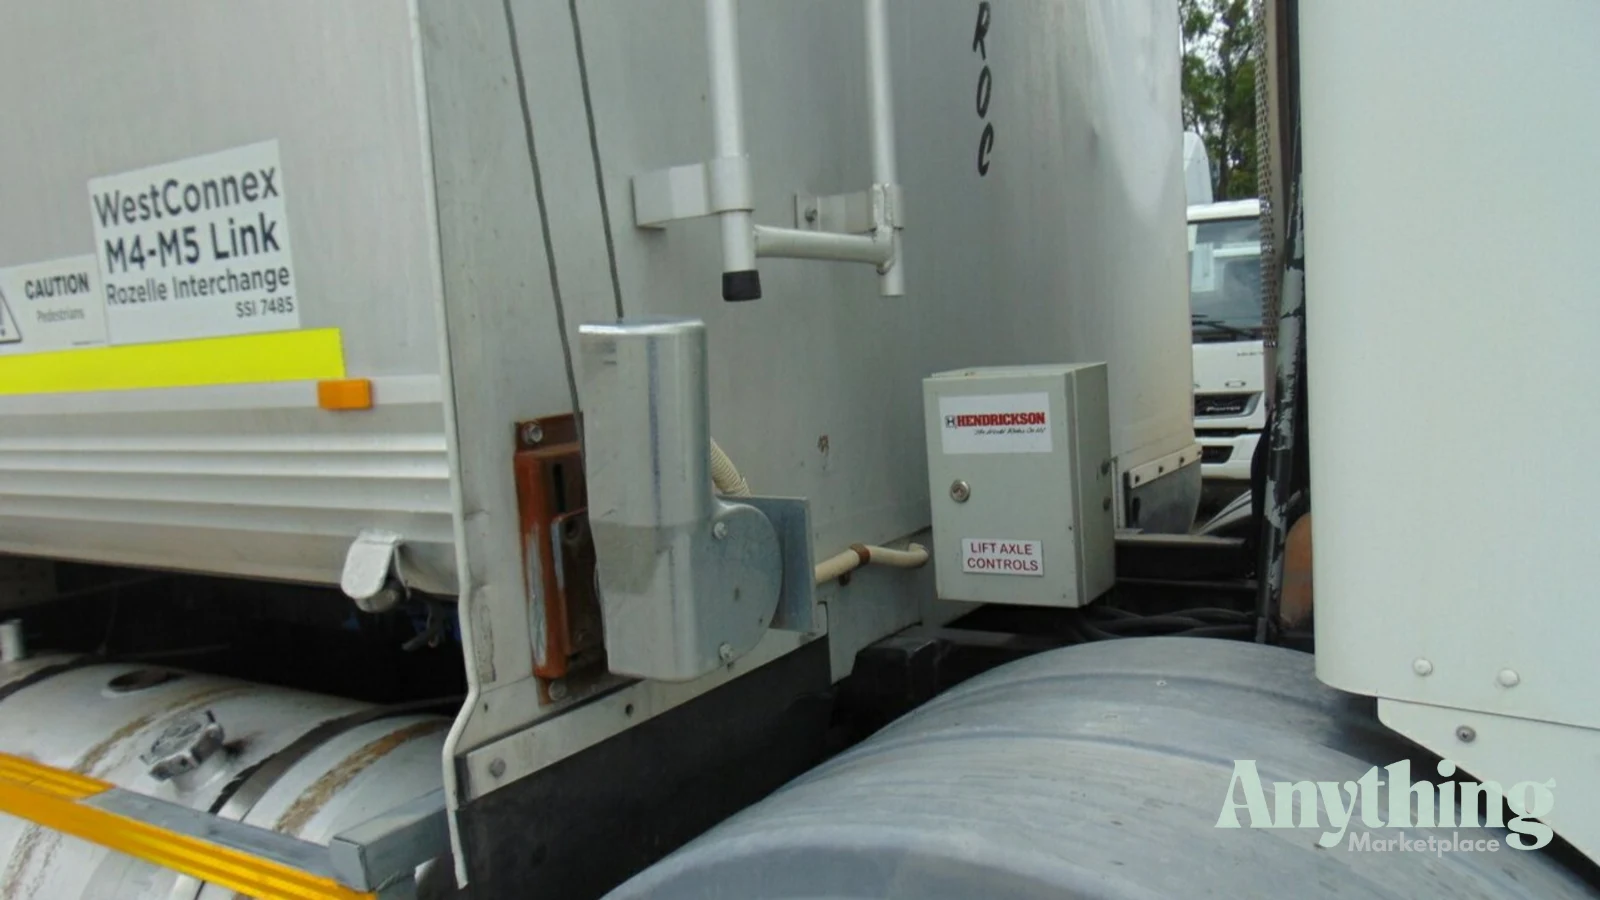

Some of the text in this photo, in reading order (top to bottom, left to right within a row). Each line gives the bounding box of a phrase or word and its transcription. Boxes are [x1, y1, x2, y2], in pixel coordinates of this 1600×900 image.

[93, 167, 278, 228] WestConnex
[104, 212, 280, 274] M4-M5 Link
[25, 272, 90, 300] CAUTION
[106, 266, 290, 305] Rozelle Interchange
[235, 296, 294, 318] SSI 7485
[957, 412, 1045, 427] HENDRICKSON
[971, 542, 1033, 555] LIFT AXLE
[967, 557, 1038, 571] CONTROLS
